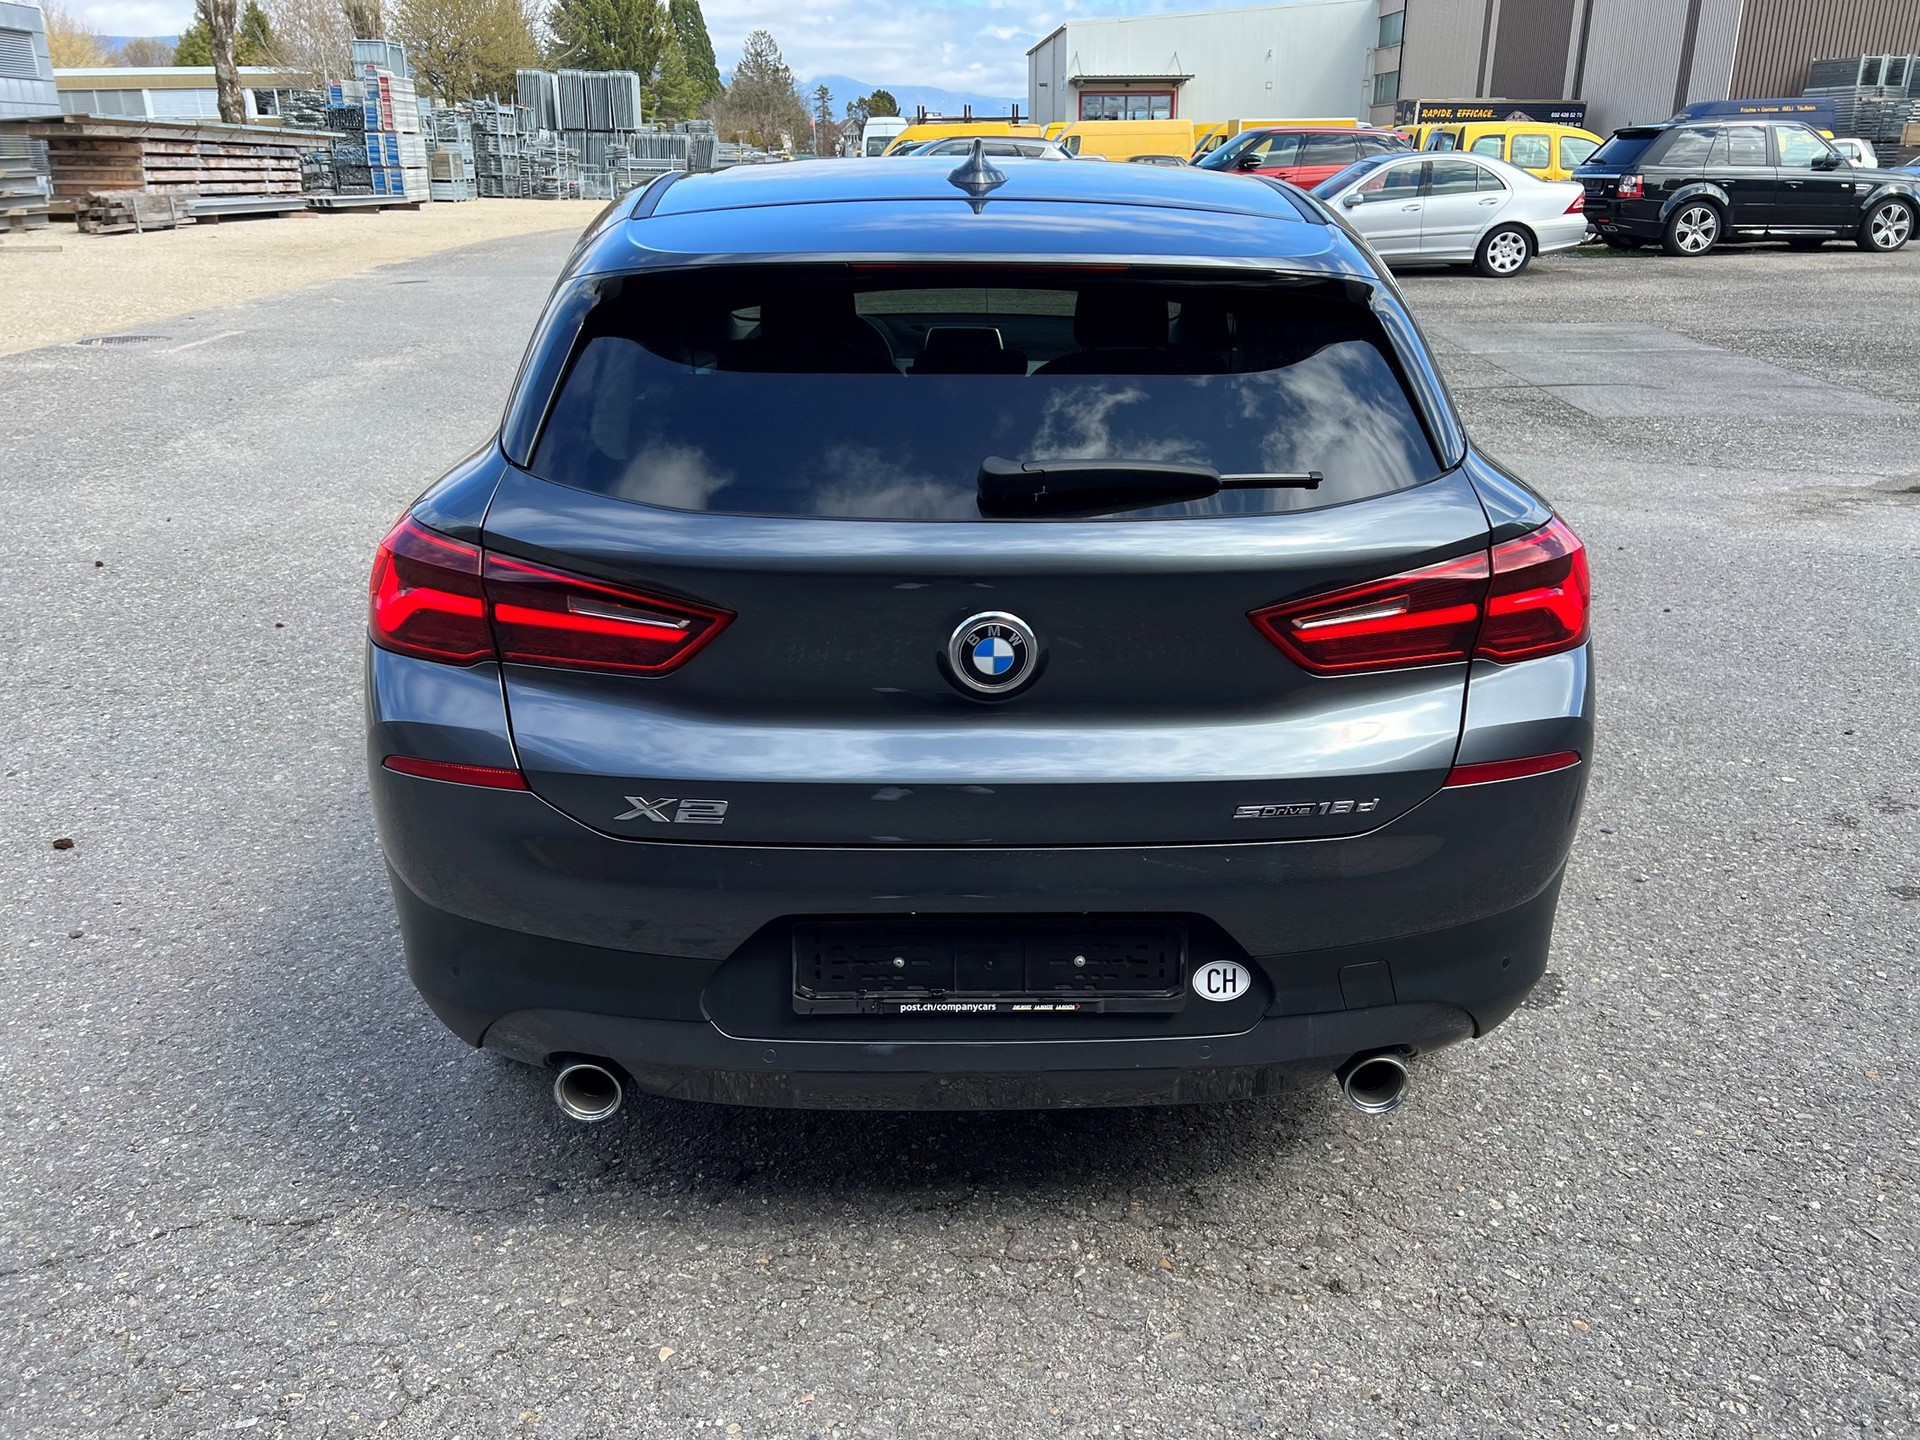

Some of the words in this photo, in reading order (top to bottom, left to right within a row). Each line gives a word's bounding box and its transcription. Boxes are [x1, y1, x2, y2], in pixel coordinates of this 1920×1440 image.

[1421, 108, 1453, 119] RAPIDE,
[967, 625, 1023, 647] BMW
[612, 795, 729, 825] X2
[1206, 967, 1237, 994] CH
[900, 1003, 997, 1013] post.ch/companycars
